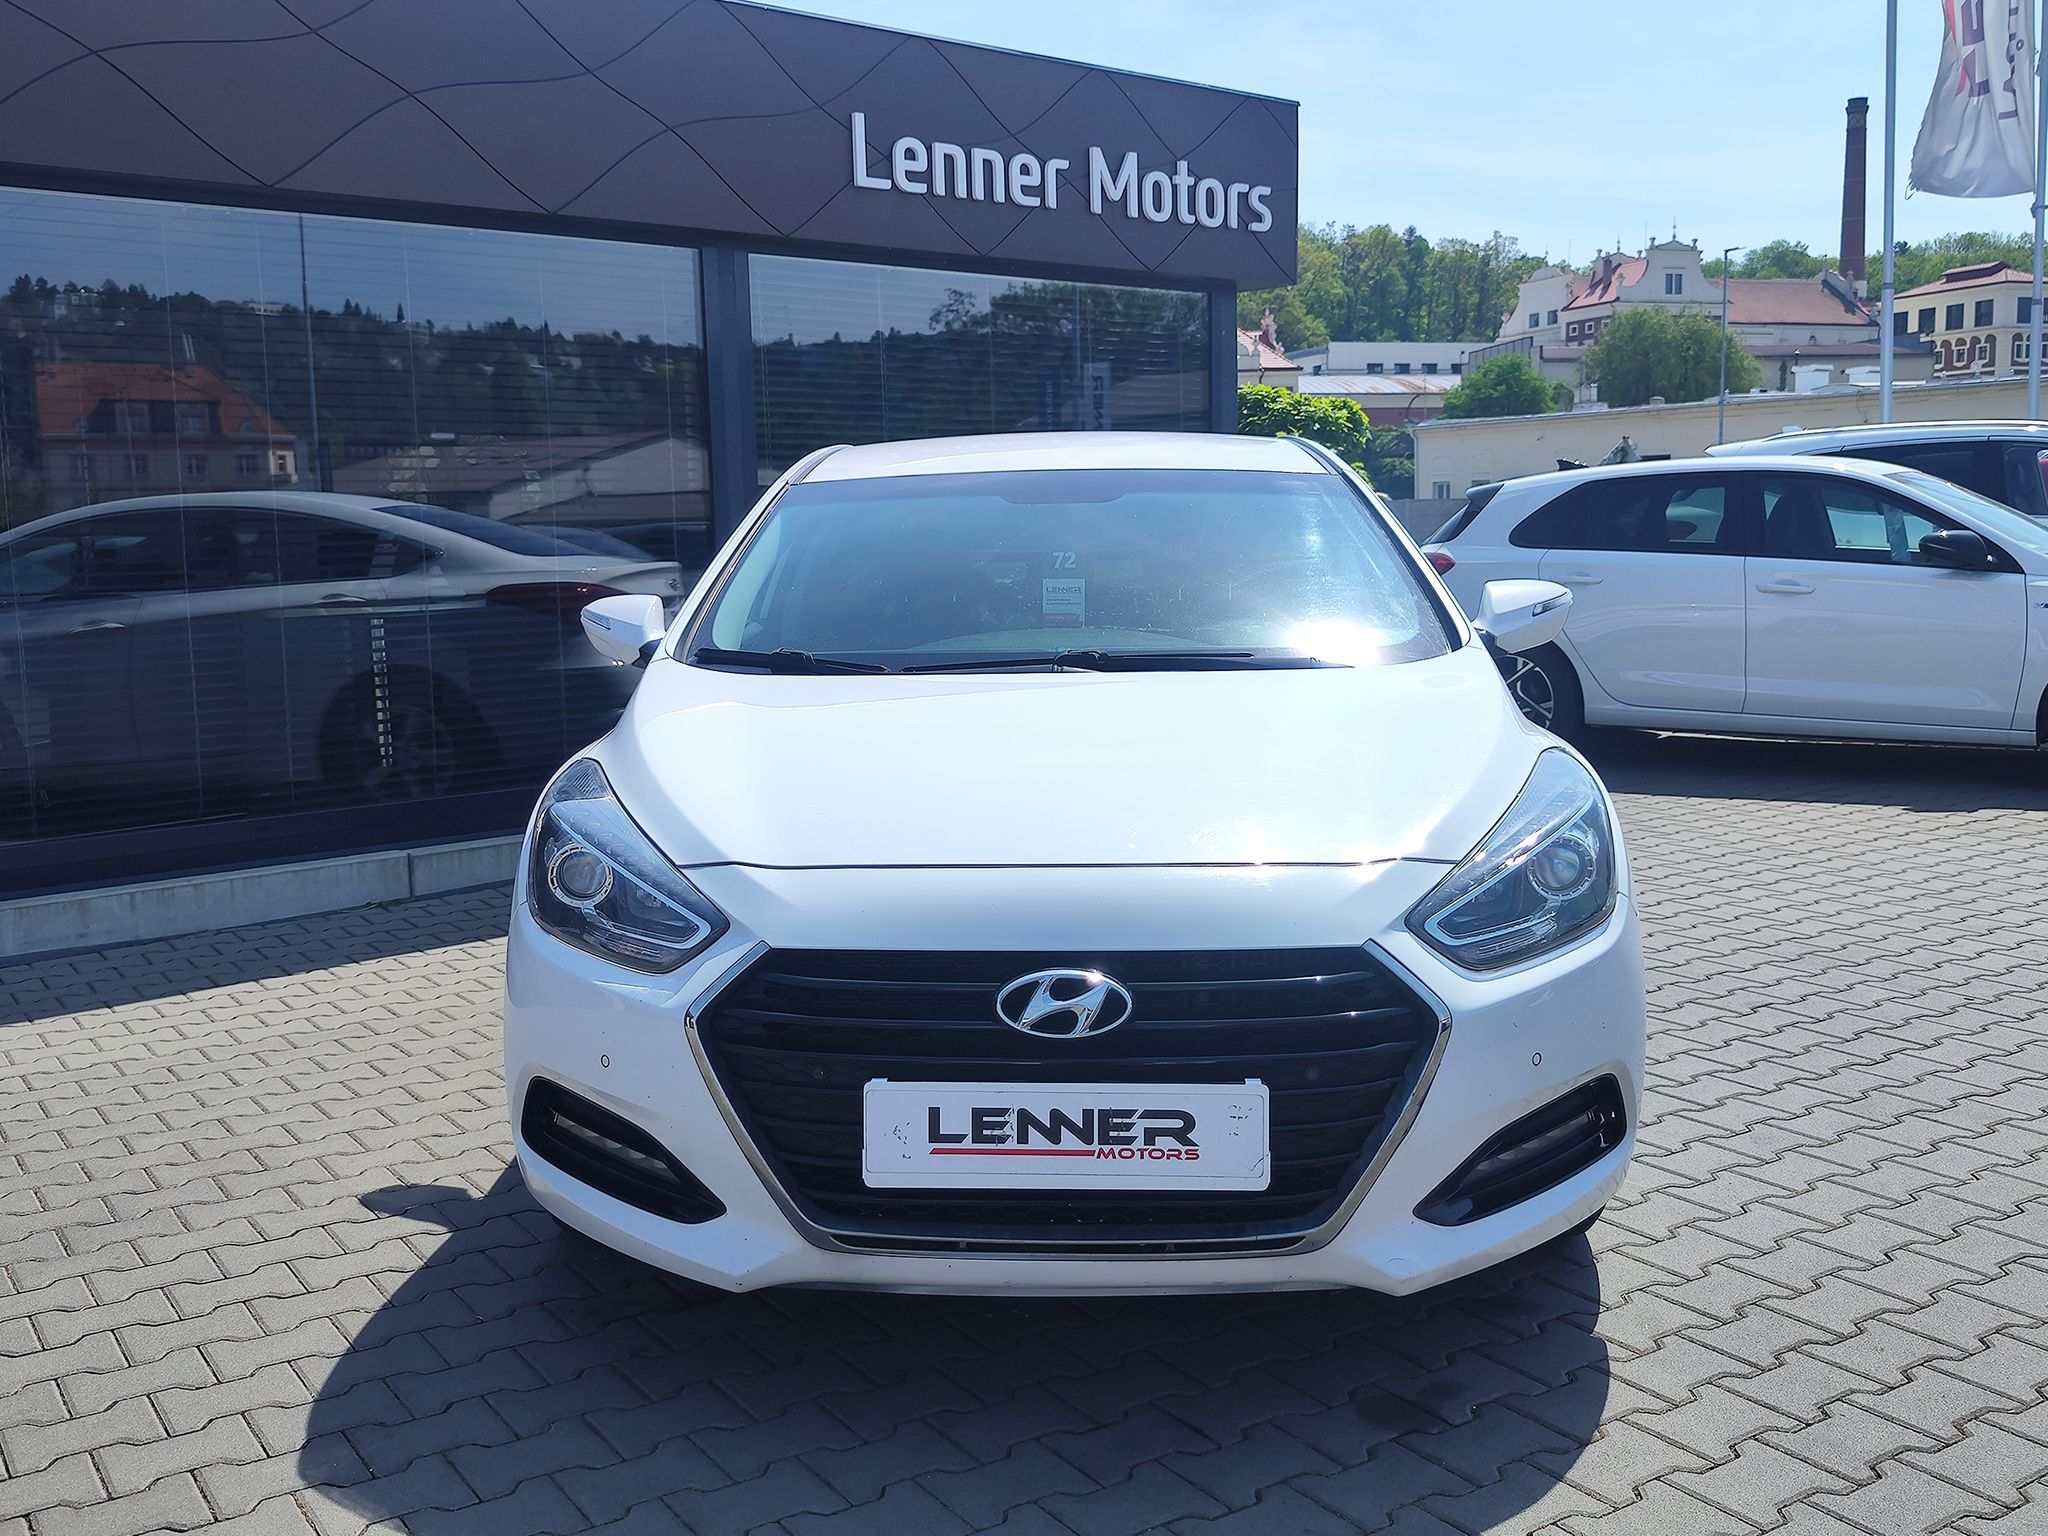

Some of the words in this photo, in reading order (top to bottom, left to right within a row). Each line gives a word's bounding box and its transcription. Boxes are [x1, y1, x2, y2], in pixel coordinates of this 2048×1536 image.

[851, 111, 1070, 211] Lenner
[1088, 146, 1272, 233] Motors
[1052, 551, 1076, 569] 72
[928, 1106, 1201, 1147] LENNER
[1096, 1147, 1201, 1161] MOTORS
